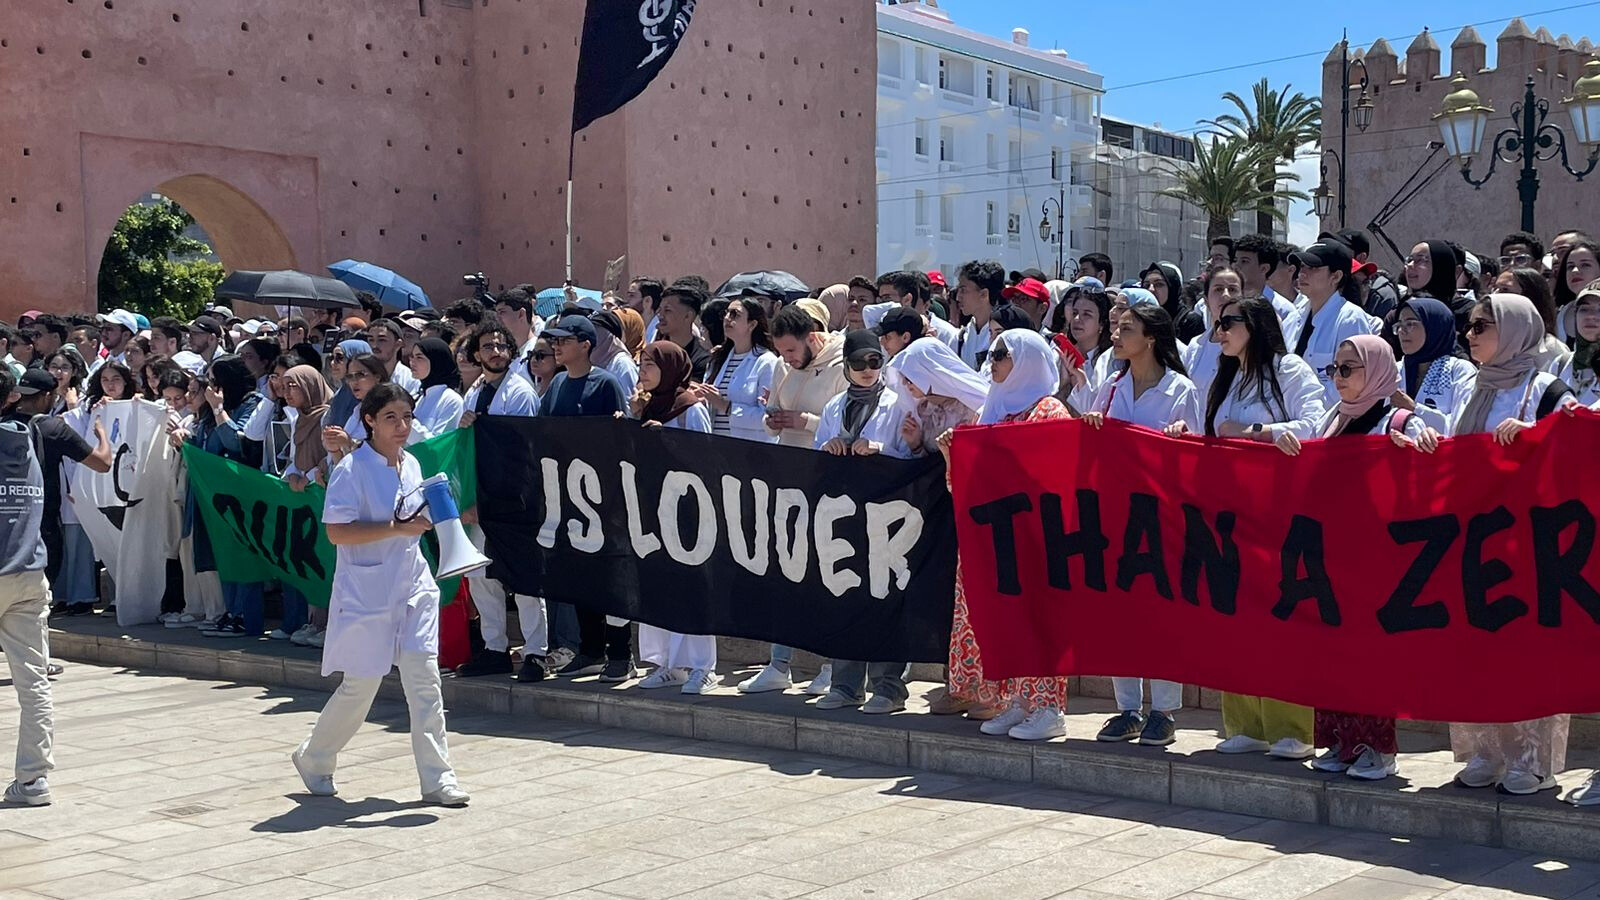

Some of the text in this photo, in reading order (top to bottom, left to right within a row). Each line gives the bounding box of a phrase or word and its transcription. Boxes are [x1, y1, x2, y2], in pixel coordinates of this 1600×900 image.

[535, 457, 924, 600] IS LOUDER
[968, 488, 1600, 635] THAN A ZER
